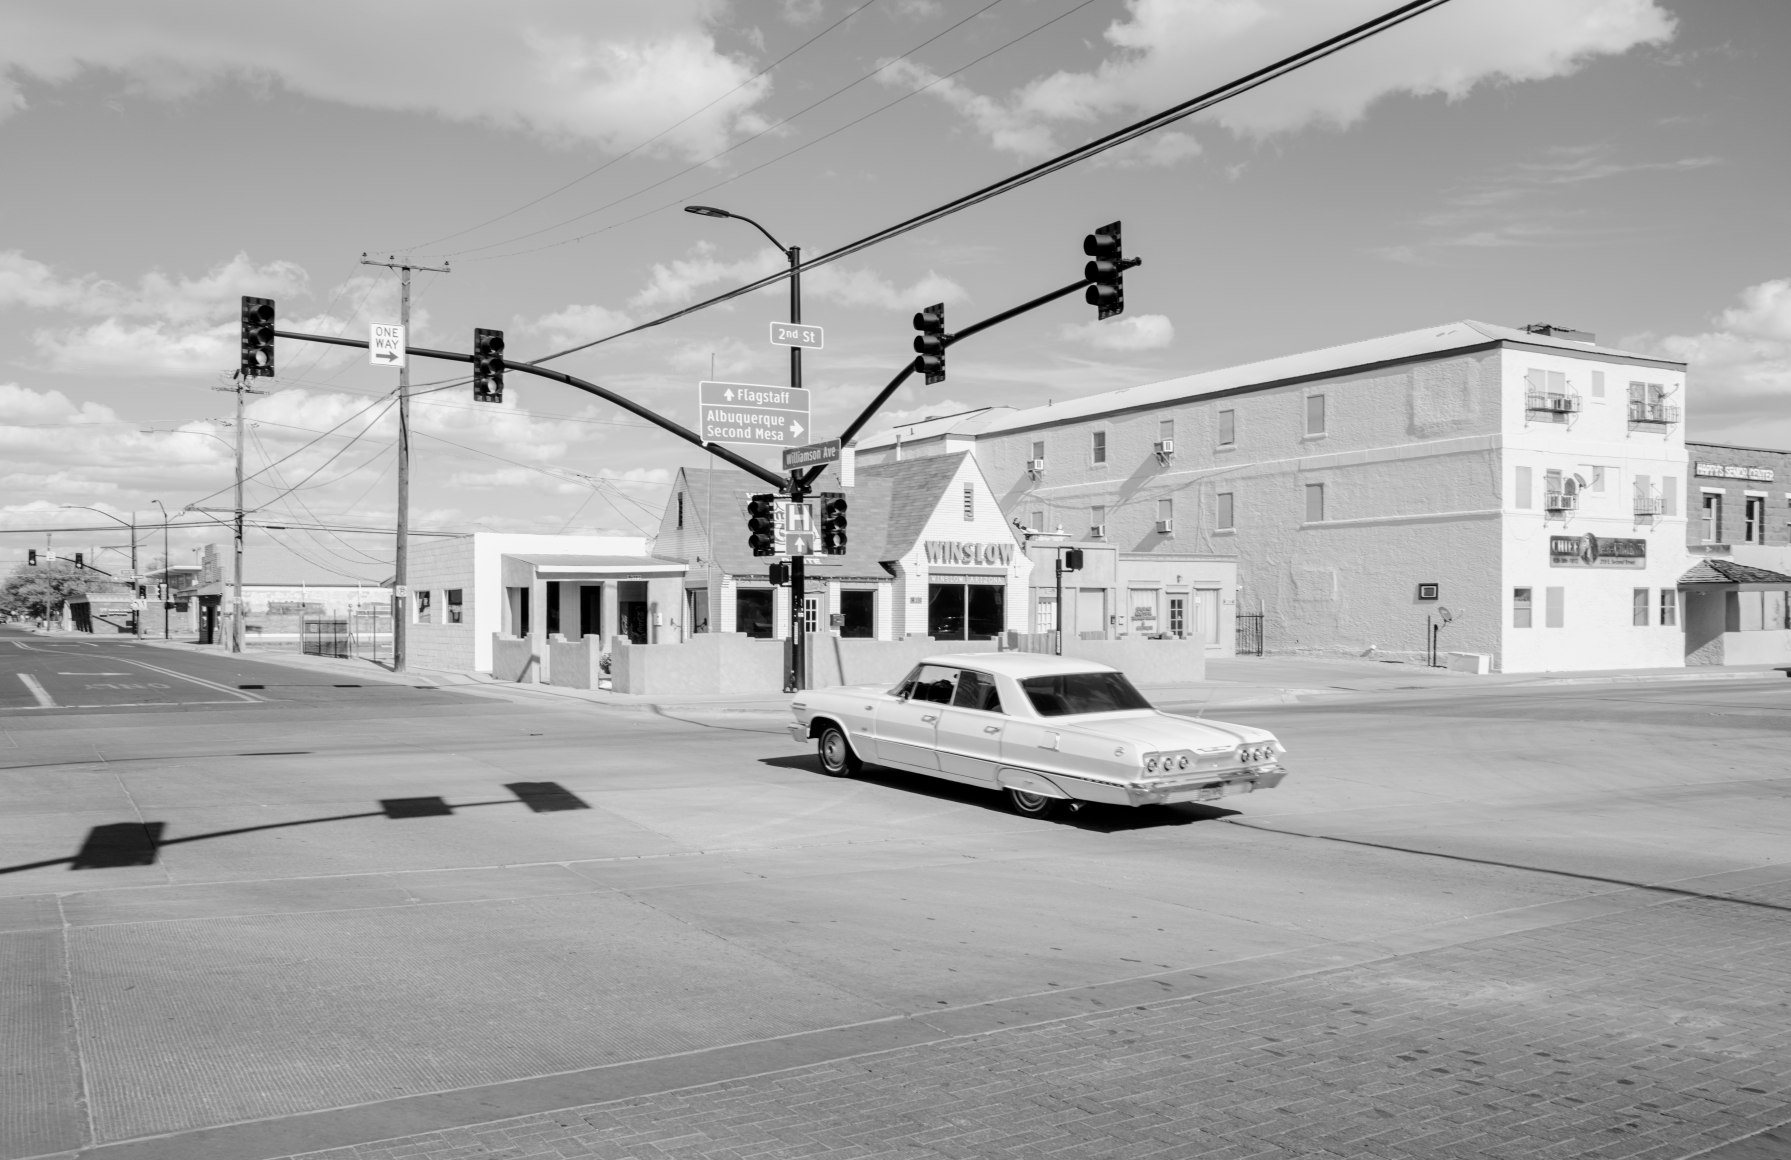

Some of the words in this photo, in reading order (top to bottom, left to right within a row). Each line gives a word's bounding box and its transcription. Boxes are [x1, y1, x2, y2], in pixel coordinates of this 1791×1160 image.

[376, 326, 399, 338] ONE
[778, 328, 799, 341] 2nd
[803, 330, 816, 343] St
[376, 338, 399, 350] WAY
[737, 388, 790, 405] Flagstaff
[706, 409, 785, 428] Albuquerque
[707, 425, 752, 439] Second
[755, 428, 784, 441] Mesa
[786, 449, 821, 465] Williamson
[823, 446, 836, 459] Ave
[789, 504, 810, 531] H
[924, 540, 1015, 566] WINSLOW
[1551, 539, 1580, 554] CHIEF
